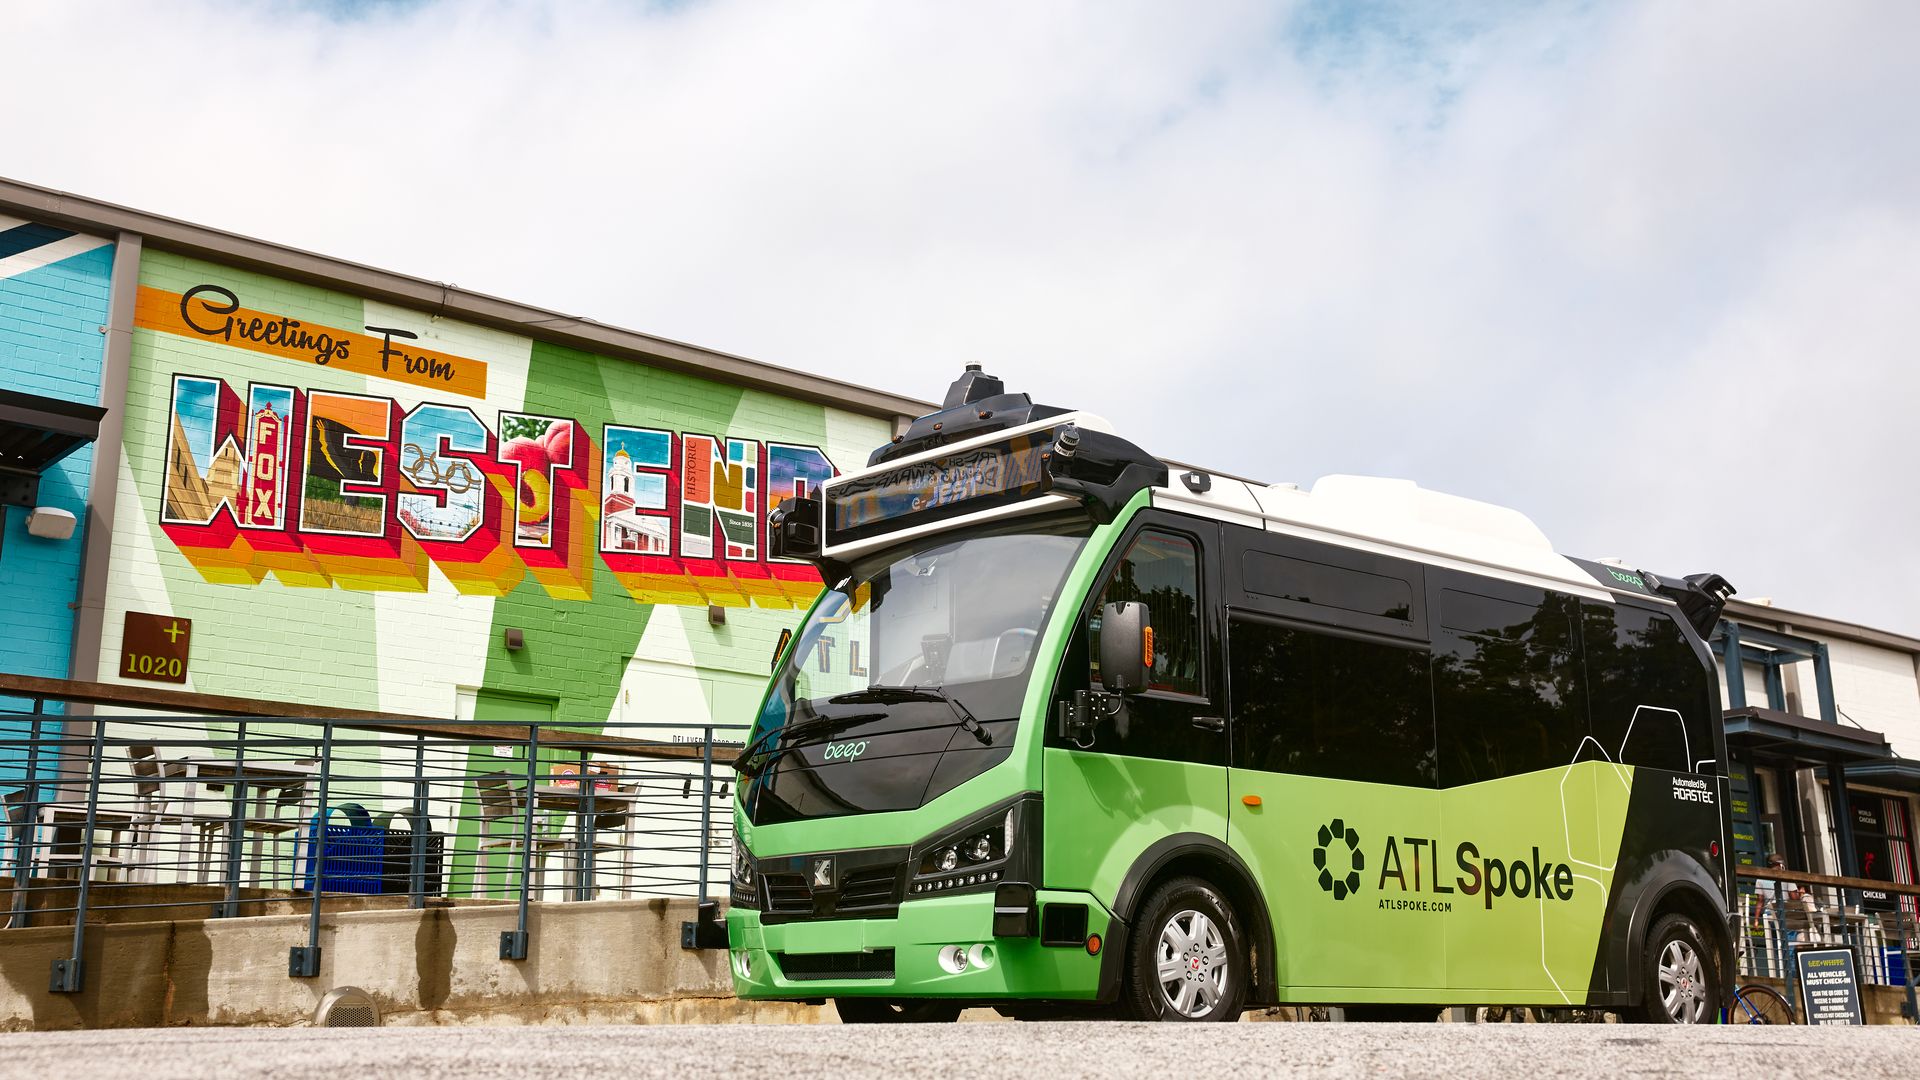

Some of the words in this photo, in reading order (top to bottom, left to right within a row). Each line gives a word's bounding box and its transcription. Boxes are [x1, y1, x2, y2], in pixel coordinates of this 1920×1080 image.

[180, 284, 350, 365] Greetings
[365, 325, 455, 382] From
[159, 372, 577, 550] WEST
[254, 422, 275, 520] FOX
[687, 440, 697, 495] HISTORIC
[729, 519, 741, 527] Since
[1606, 567, 1645, 589] beep
[127, 653, 182, 677] 1020
[1672, 776, 1700, 789] Automated
[1699, 779, 1708, 791] By
[1379, 899, 1452, 912] ATLSPOKE.COM
[1862, 890, 1887, 900] CHICKEN
[1818, 970, 1847, 978] VEHICLES
